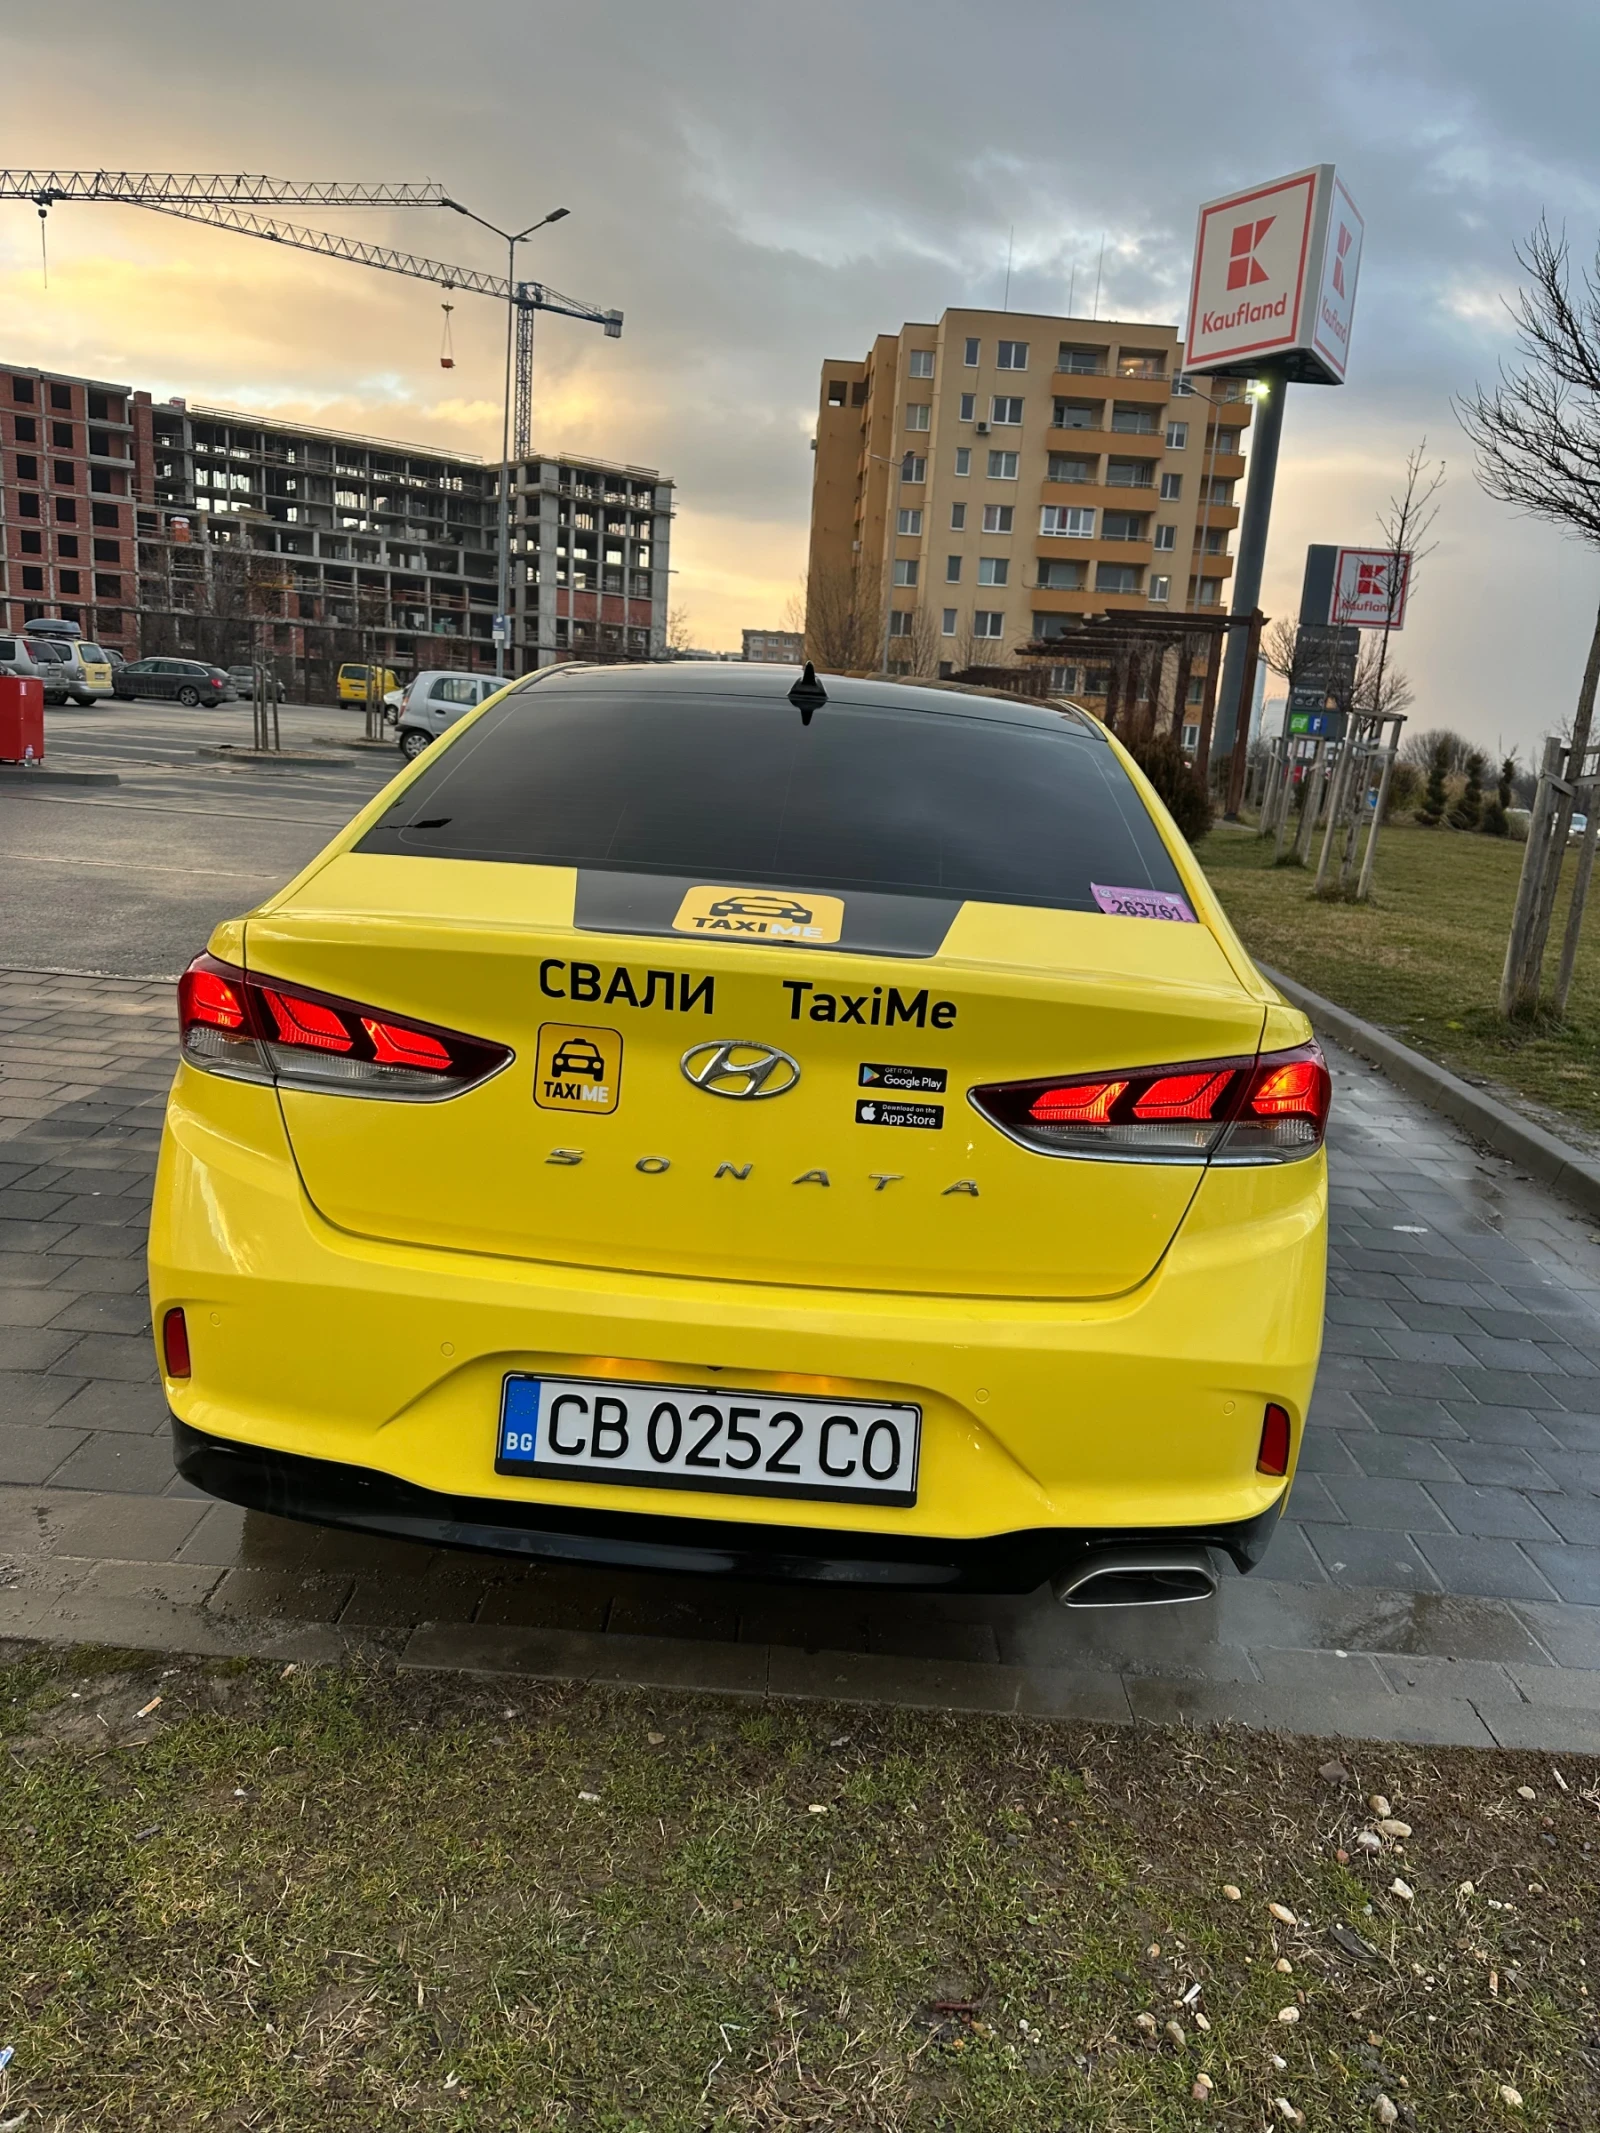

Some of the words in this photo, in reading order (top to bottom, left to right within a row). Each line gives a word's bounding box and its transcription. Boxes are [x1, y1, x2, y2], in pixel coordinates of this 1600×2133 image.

[1201, 292, 1287, 335] Kaufland
[1111, 900, 1184, 921] 263761
[539, 958, 715, 1015] СВАЛИ
[782, 980, 957, 1030] TaxiMe
[884, 1074, 920, 1088] Google
[921, 1077, 942, 1090] Play
[881, 1111, 904, 1126] App
[906, 1113, 936, 1126] Store
[882, 1104, 914, 1112] Download
[545, 1147, 980, 1197] SONATA
[506, 1431, 533, 1452] BG
[647, 1401, 804, 1474] 0252
